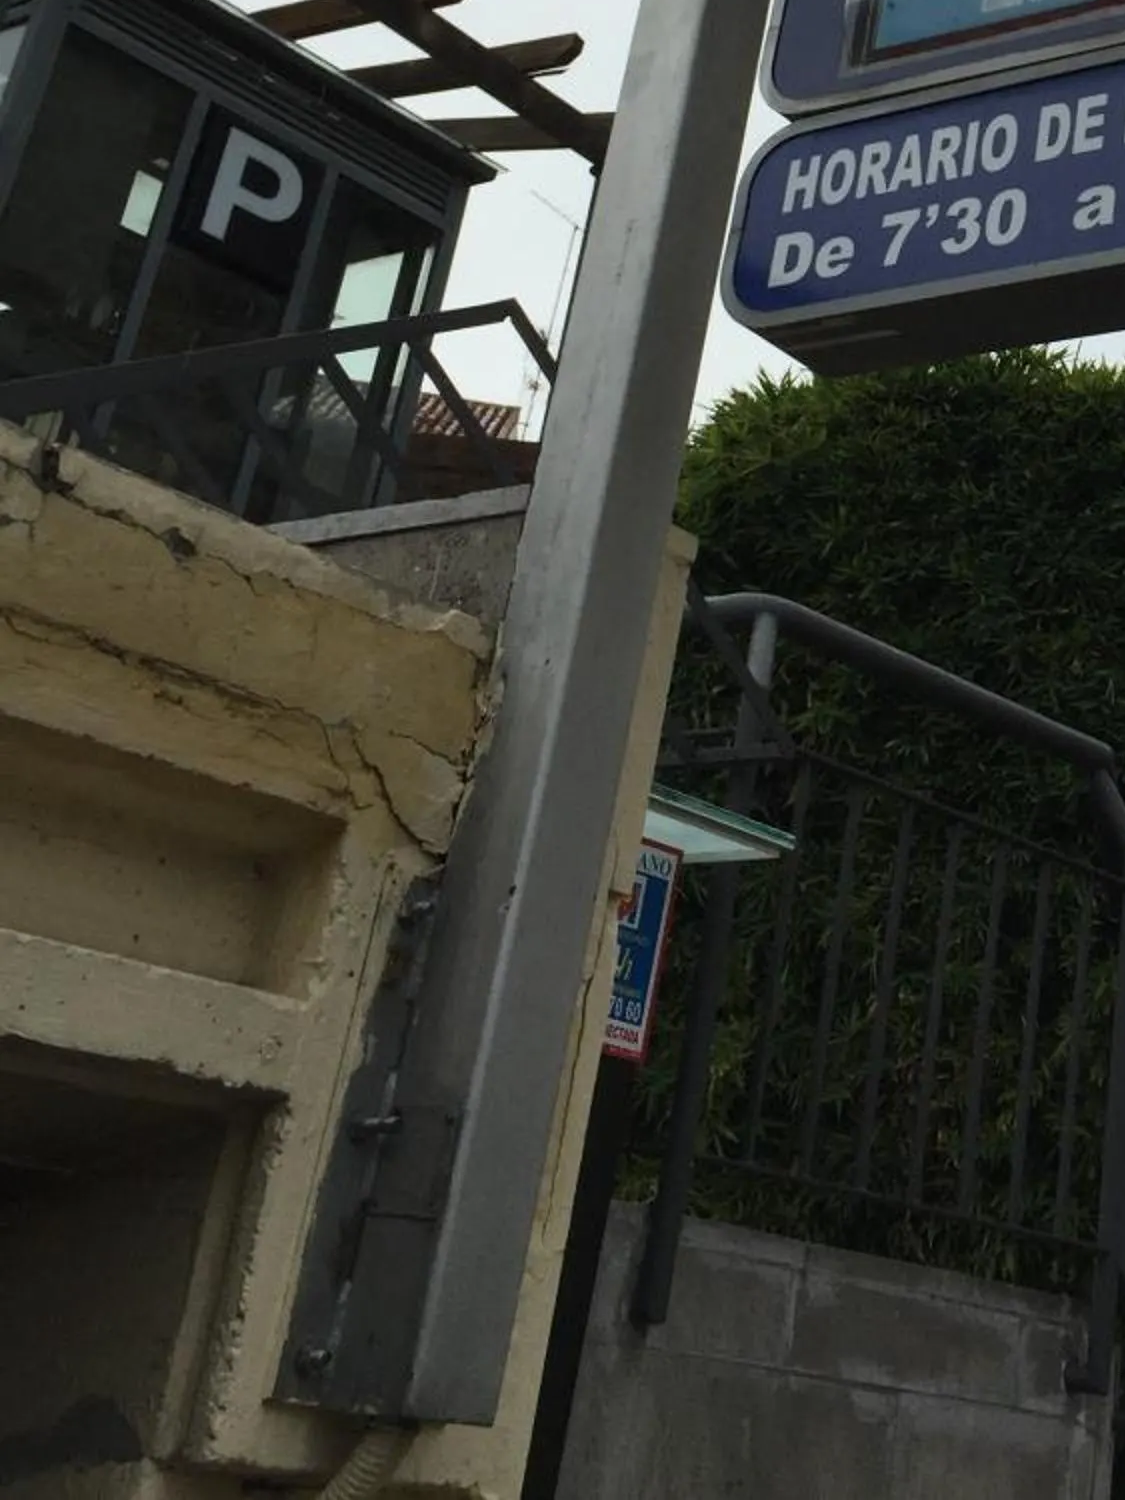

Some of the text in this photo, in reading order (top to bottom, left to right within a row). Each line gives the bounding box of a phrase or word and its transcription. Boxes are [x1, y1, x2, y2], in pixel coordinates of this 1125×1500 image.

[200, 126, 303, 242] P
[781, 114, 1019, 214] HORARIO
[1033, 93, 1109, 159] DE
[767, 230, 854, 289] De
[880, 187, 1028, 268] 7'30
[1071, 183, 1117, 232] a
